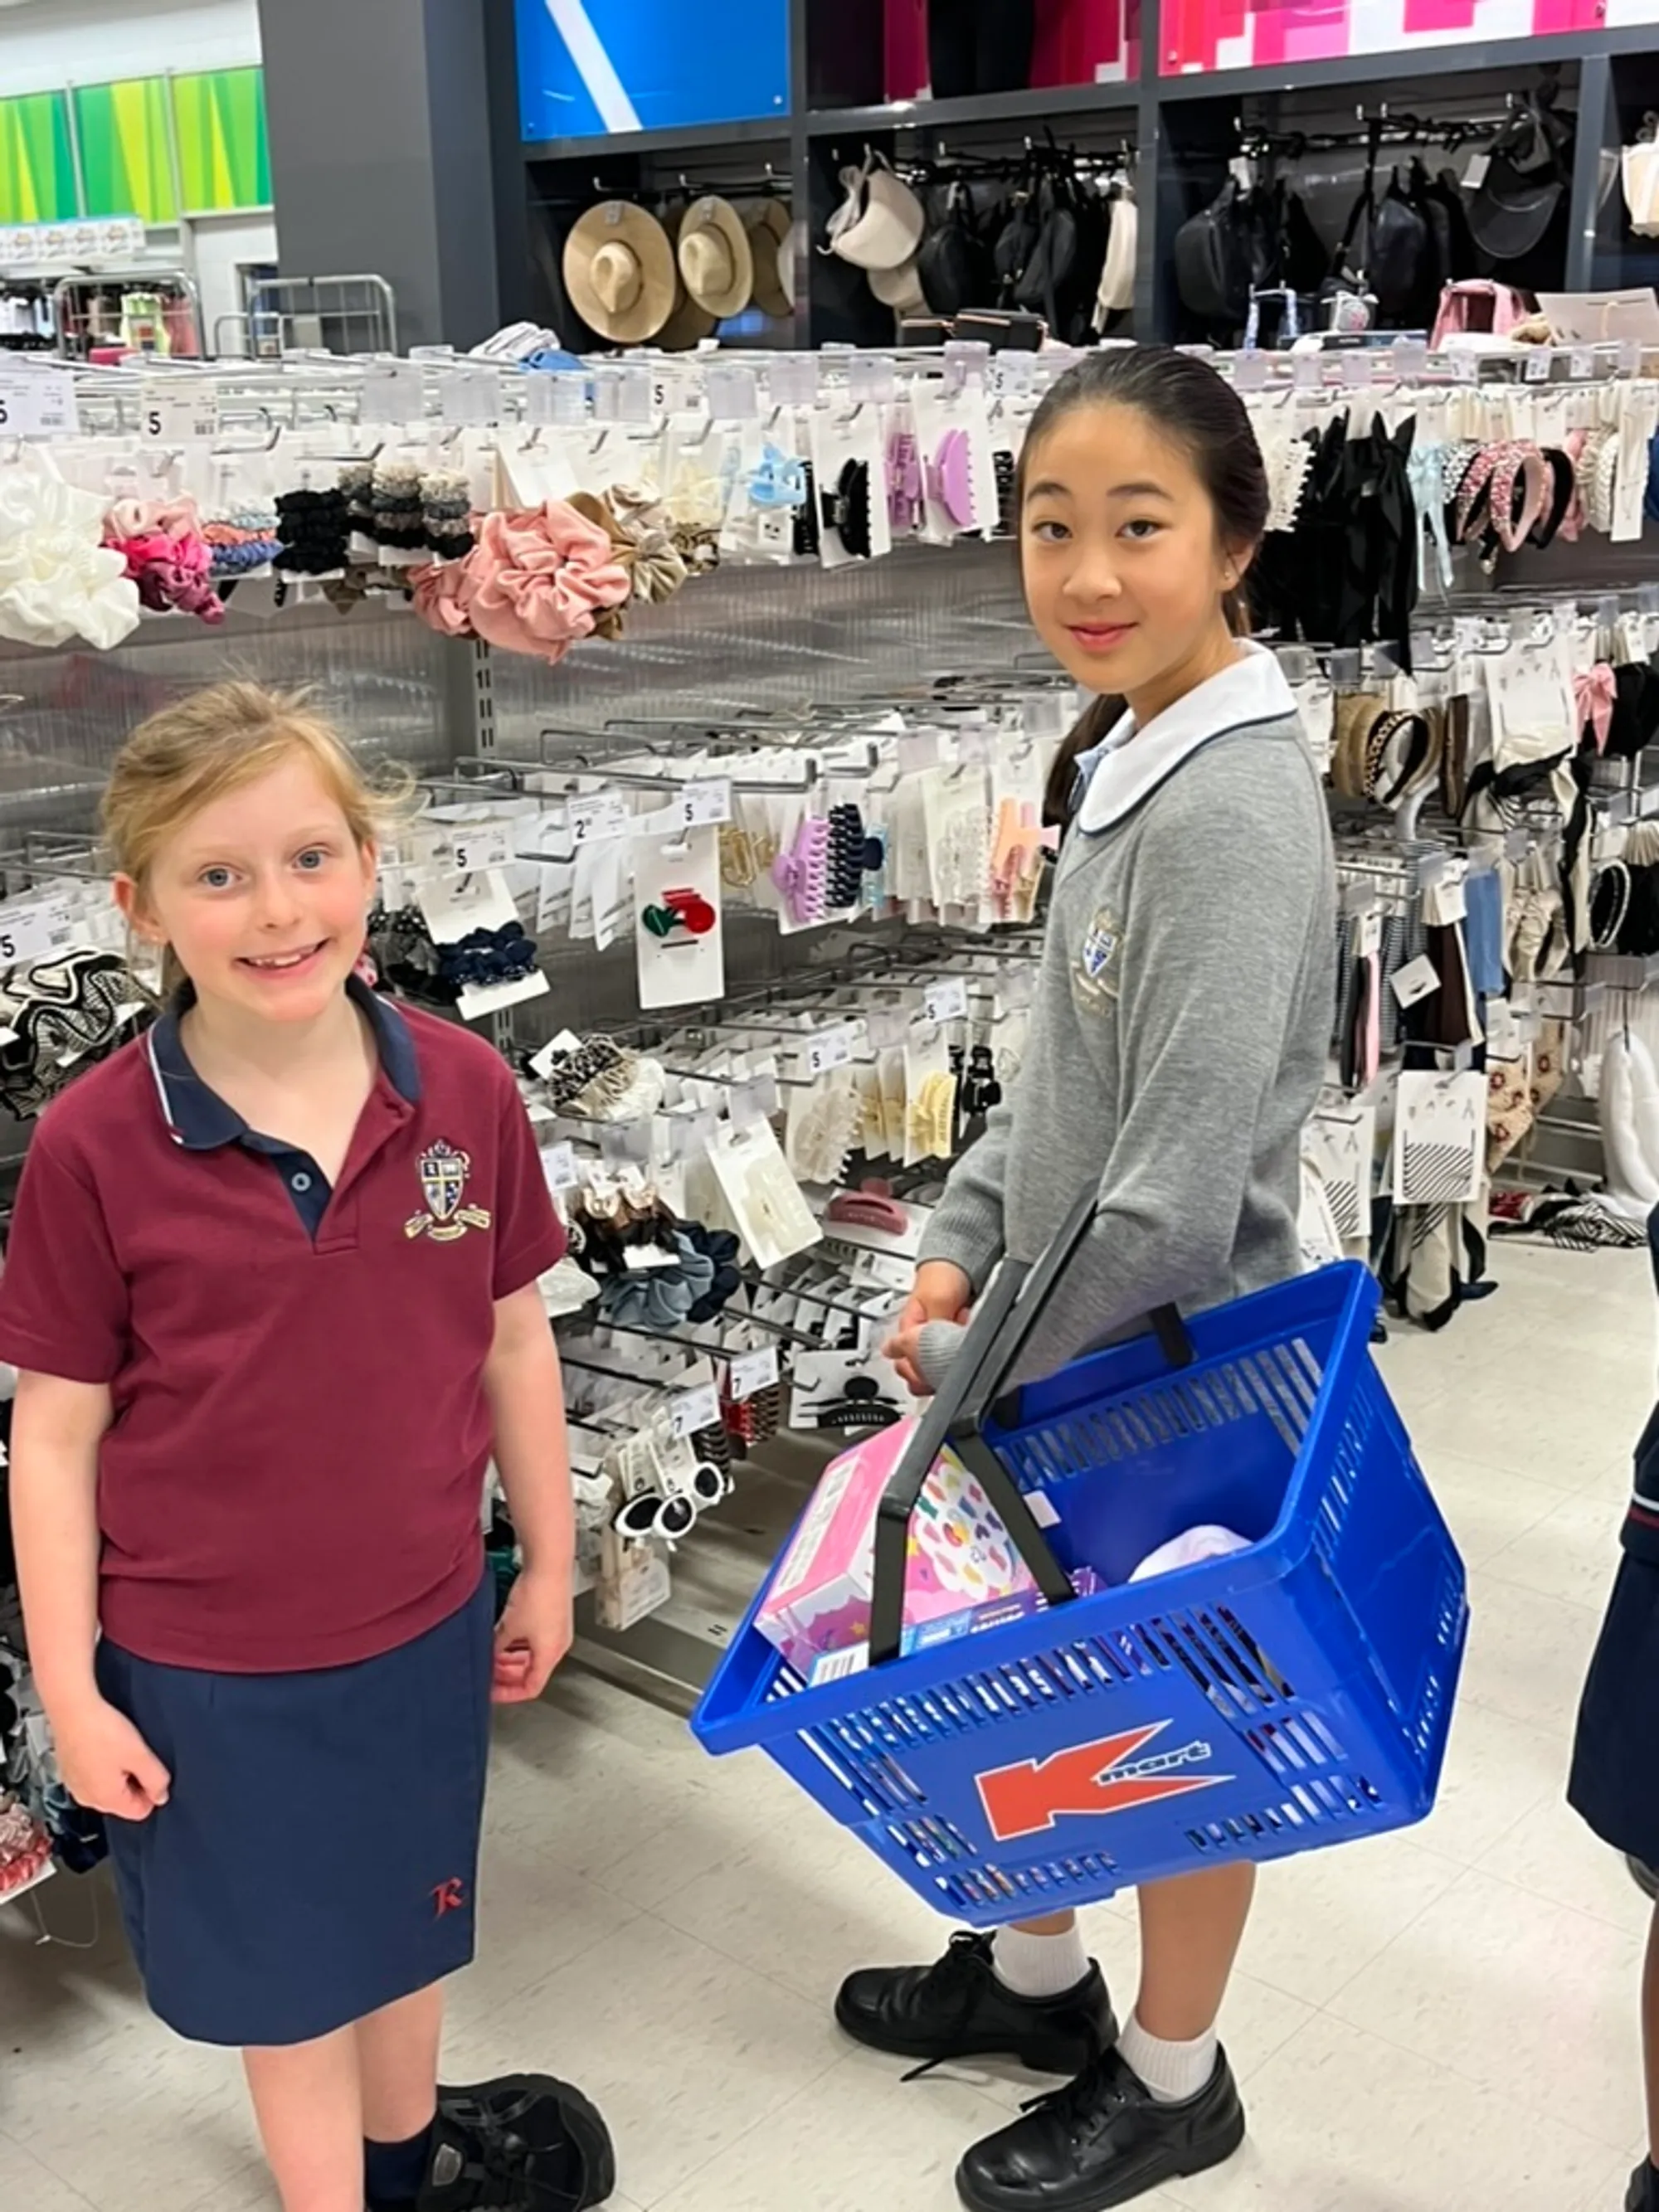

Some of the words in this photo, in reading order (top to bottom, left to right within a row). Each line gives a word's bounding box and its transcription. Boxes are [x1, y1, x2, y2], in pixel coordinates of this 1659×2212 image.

[654, 384, 664, 405] 5
[148, 411, 161, 435] 5
[685, 804, 693, 822] 5
[457, 848, 467, 868] 5
[1, 934, 16, 958] 5
[927, 1004, 936, 1020] 5
[812, 1052, 820, 1068] 5
[733, 1377, 742, 1395] 7
[974, 1719, 1237, 1842] Kmart
